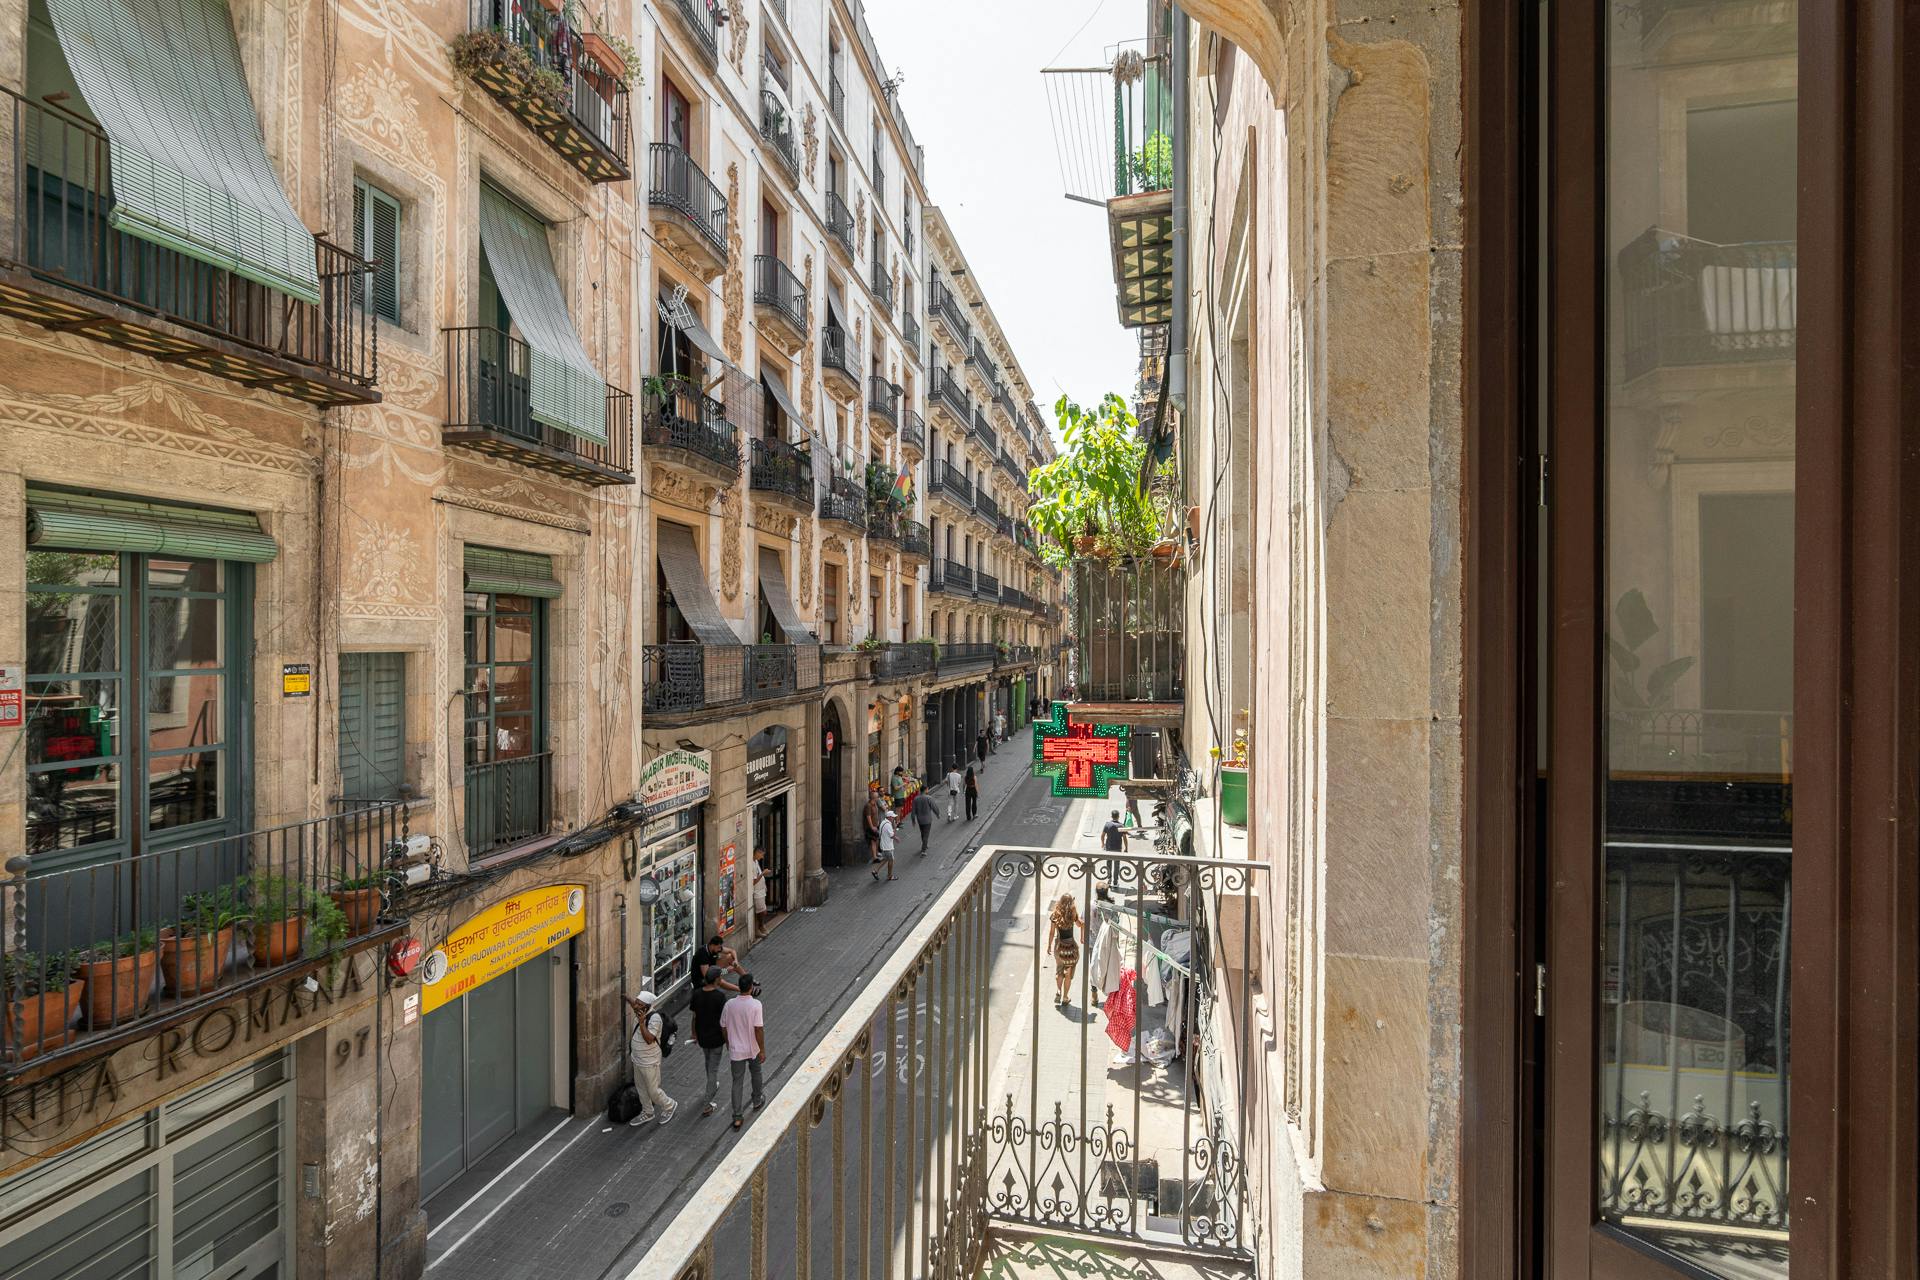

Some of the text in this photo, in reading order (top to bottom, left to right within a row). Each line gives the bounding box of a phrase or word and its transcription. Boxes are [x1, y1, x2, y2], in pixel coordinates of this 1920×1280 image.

[688, 753, 709, 774] HOUSE
[461, 940, 506, 968] GURUDWARA
[507, 922, 548, 946] GURDARSHAN
[547, 927, 571, 945] INDIA
[444, 974, 476, 999] INDIA
[156, 955, 364, 1081] ROMANA
[336, 1025, 371, 1068] 97
